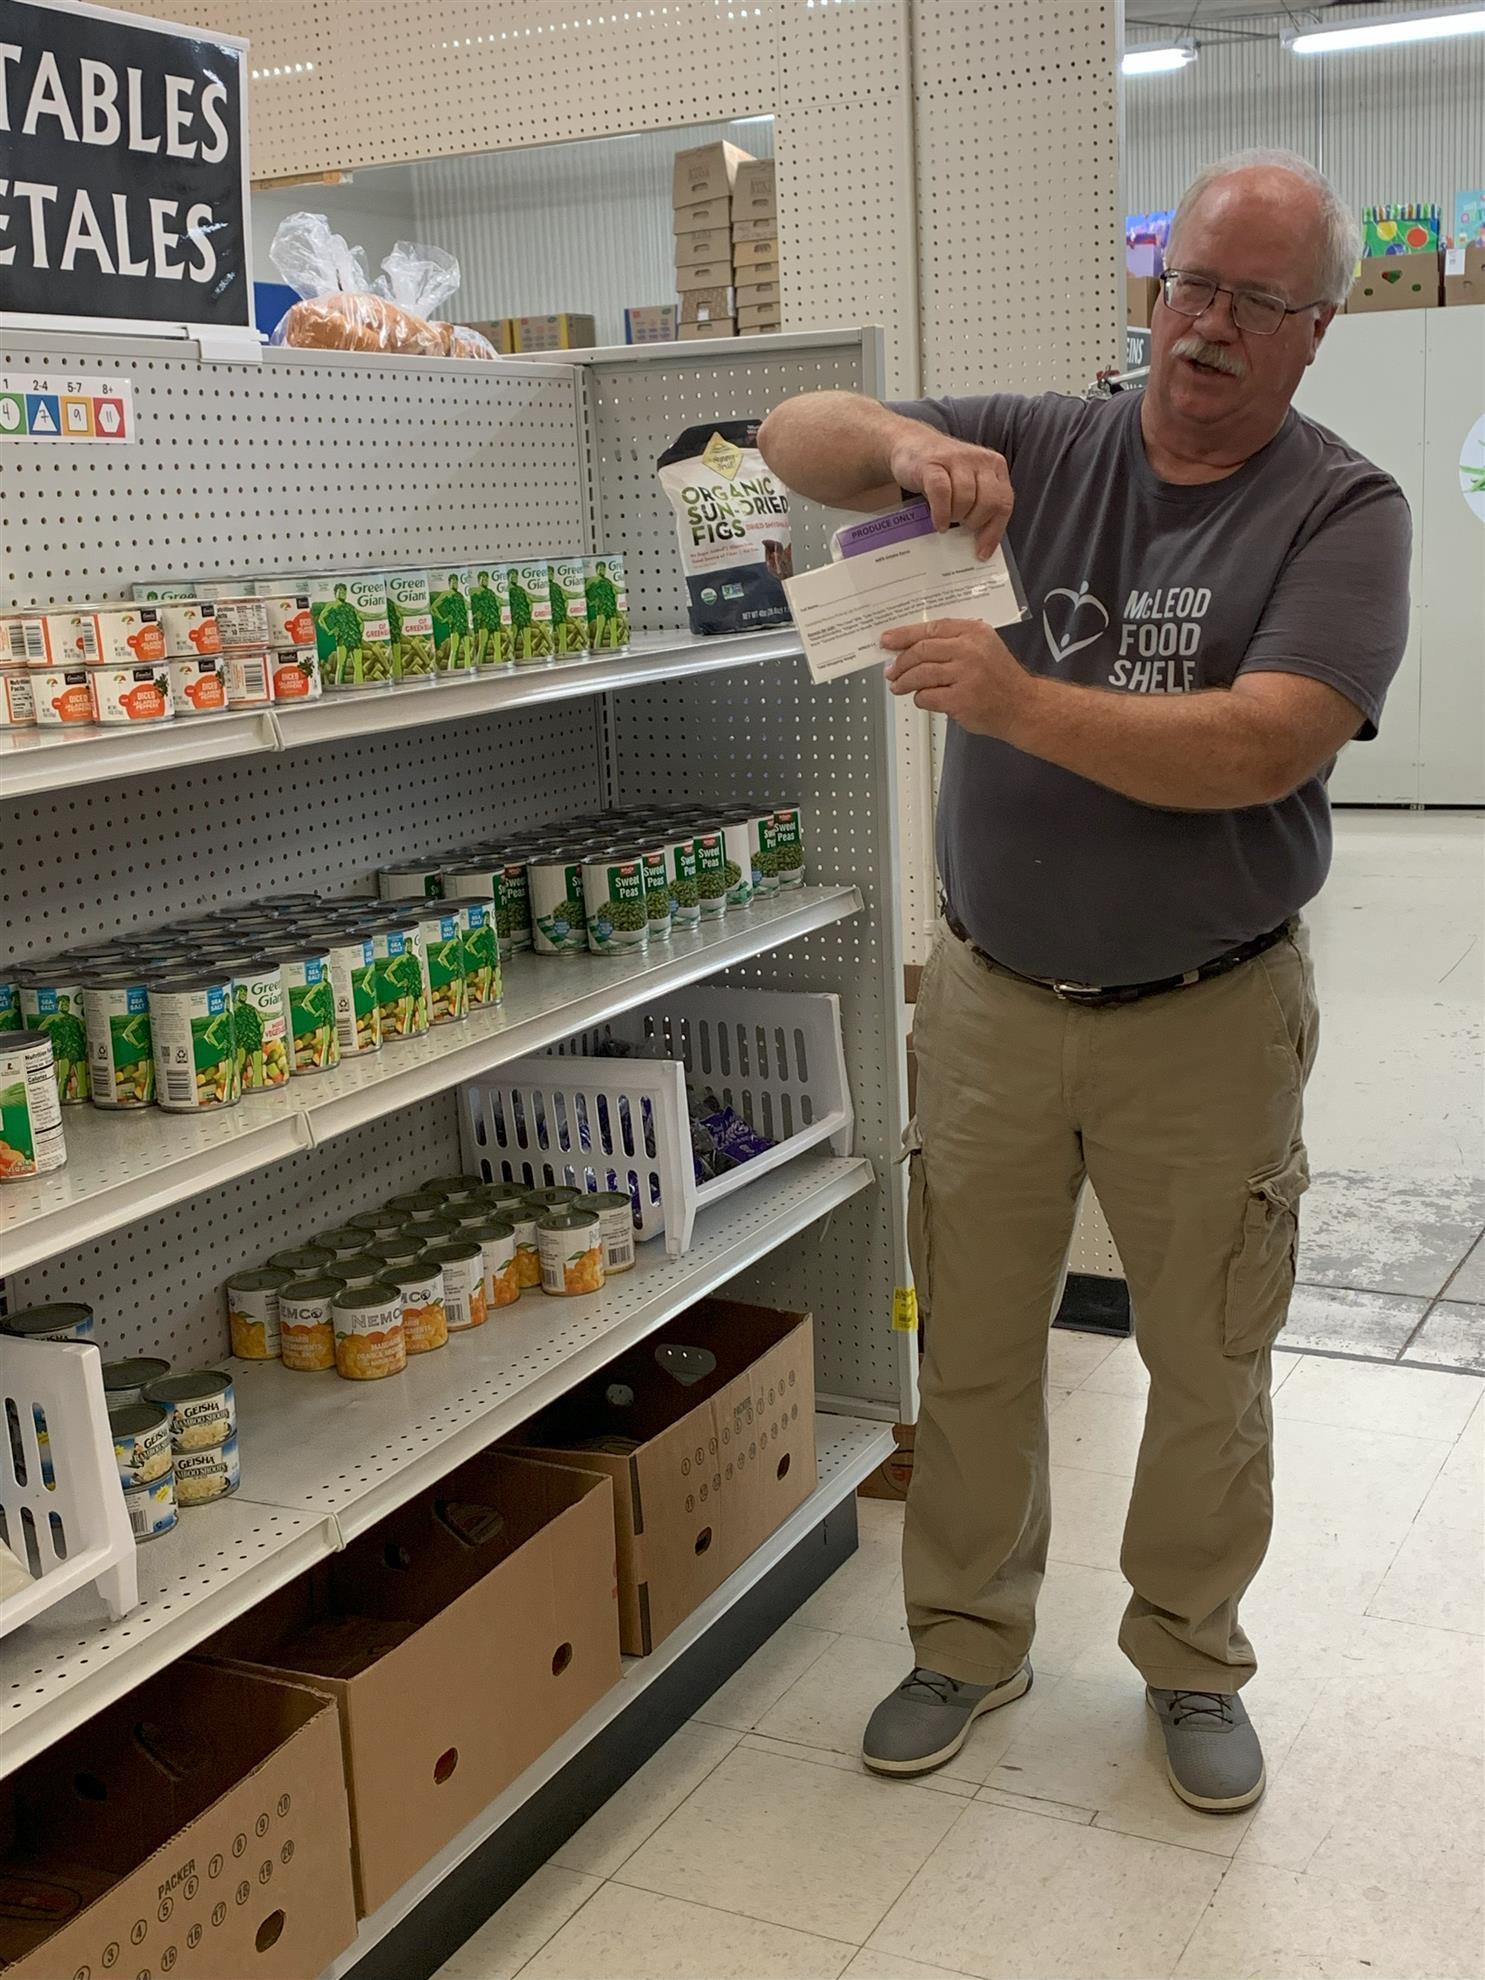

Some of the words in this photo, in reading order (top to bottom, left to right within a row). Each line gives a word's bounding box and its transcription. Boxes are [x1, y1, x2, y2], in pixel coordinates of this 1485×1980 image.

[33, 380, 48, 391] 2-4
[67, 382, 82, 393] 5-7
[102, 384, 114, 394] 8+
[3, 403, 10, 421] 4
[74, 409, 82, 421] 9
[681, 477, 775, 504] ORGANIC
[687, 495, 788, 525] SUN-DRIED
[691, 519, 746, 546] FIGS
[851, 519, 892, 540] PRODUCE
[893, 510, 916, 527] ONLY
[1123, 587, 1212, 619] McLEOD
[1118, 623, 1201, 657] FOOD
[1108, 659, 1197, 693] SHELF
[777, 832, 795, 842] Peas
[702, 858, 719, 868] Peas
[647, 876, 665, 887] Peas
[620, 887, 639, 898] Peas
[251, 981, 280, 995] Gree
[352, 1307, 402, 1328] NEMC
[184, 1402, 220, 1417] GEISHA
[178, 1456, 215, 1470] GEISHA
[158, 1858, 196, 1900] PACKER
